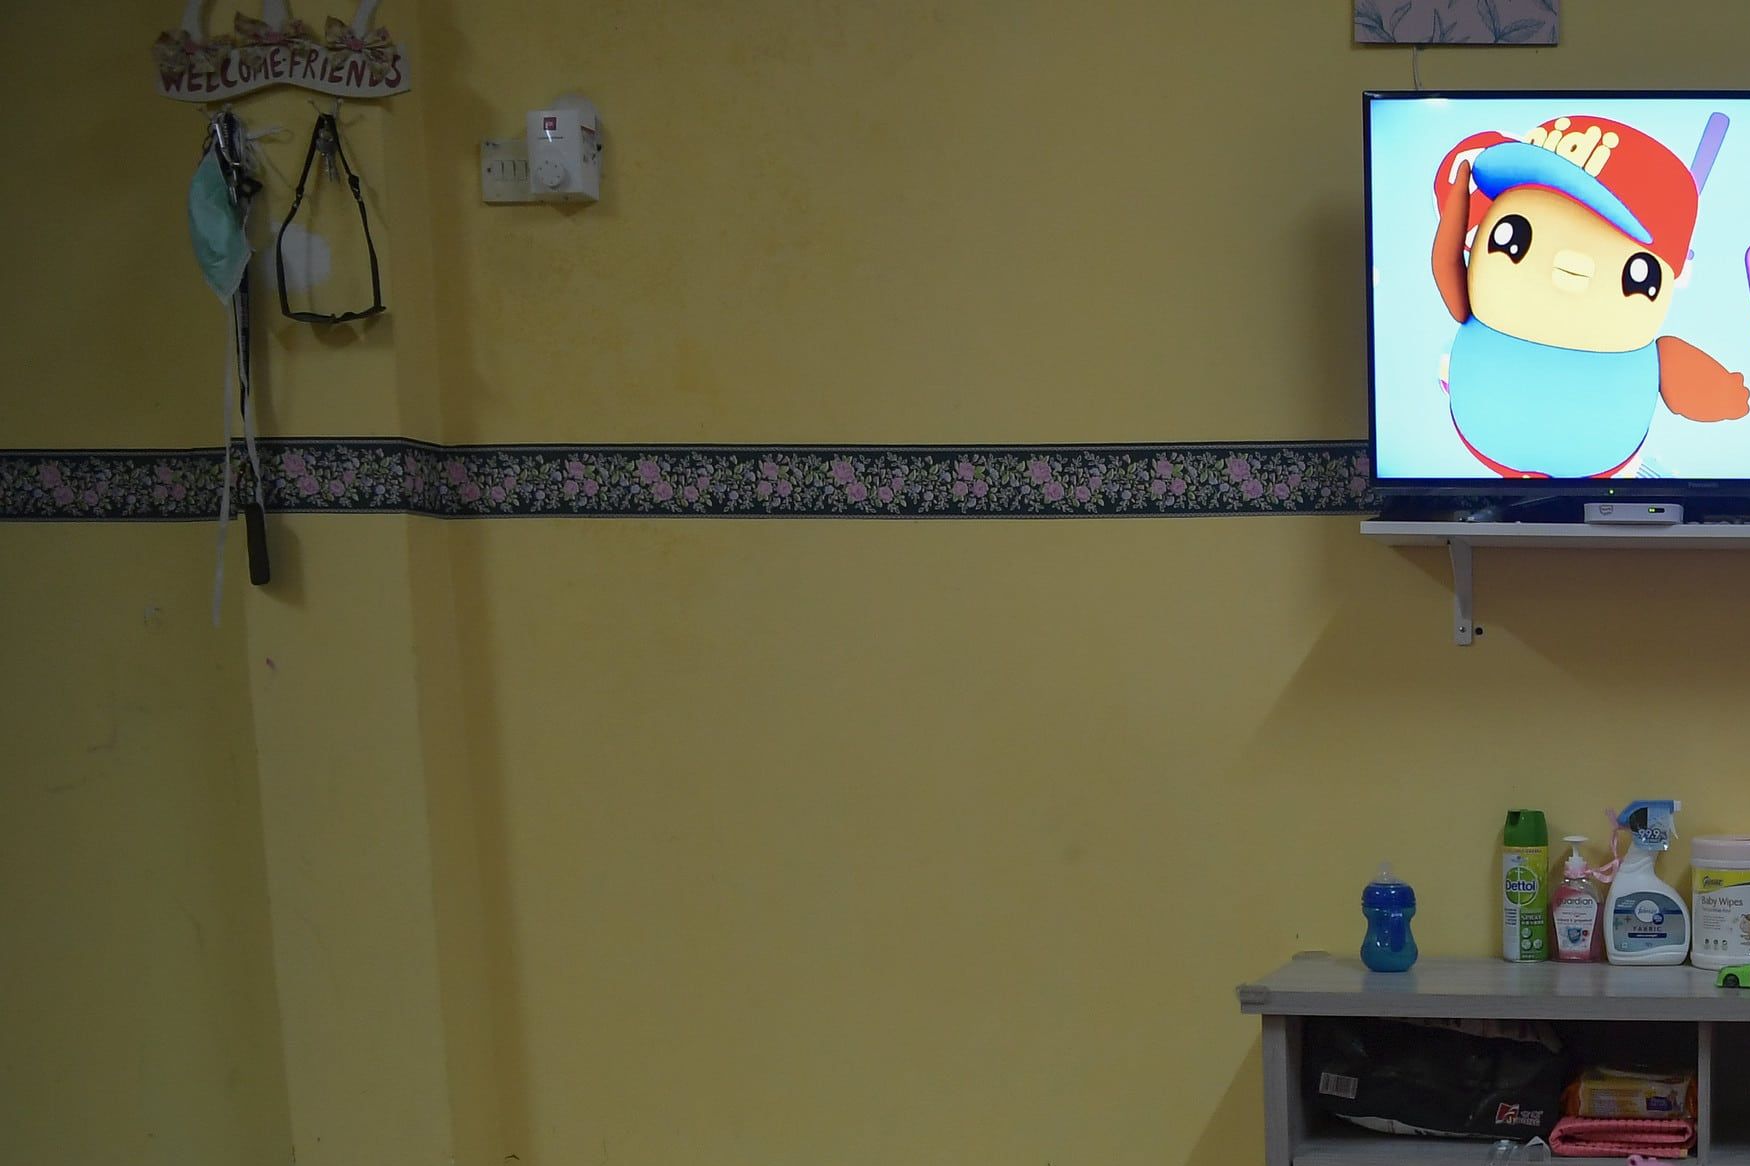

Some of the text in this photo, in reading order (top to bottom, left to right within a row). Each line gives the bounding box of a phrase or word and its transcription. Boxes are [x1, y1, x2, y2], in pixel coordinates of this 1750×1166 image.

[1505, 880, 1536, 891] Dettol
[1701, 896, 1743, 908] Baby Wipes
